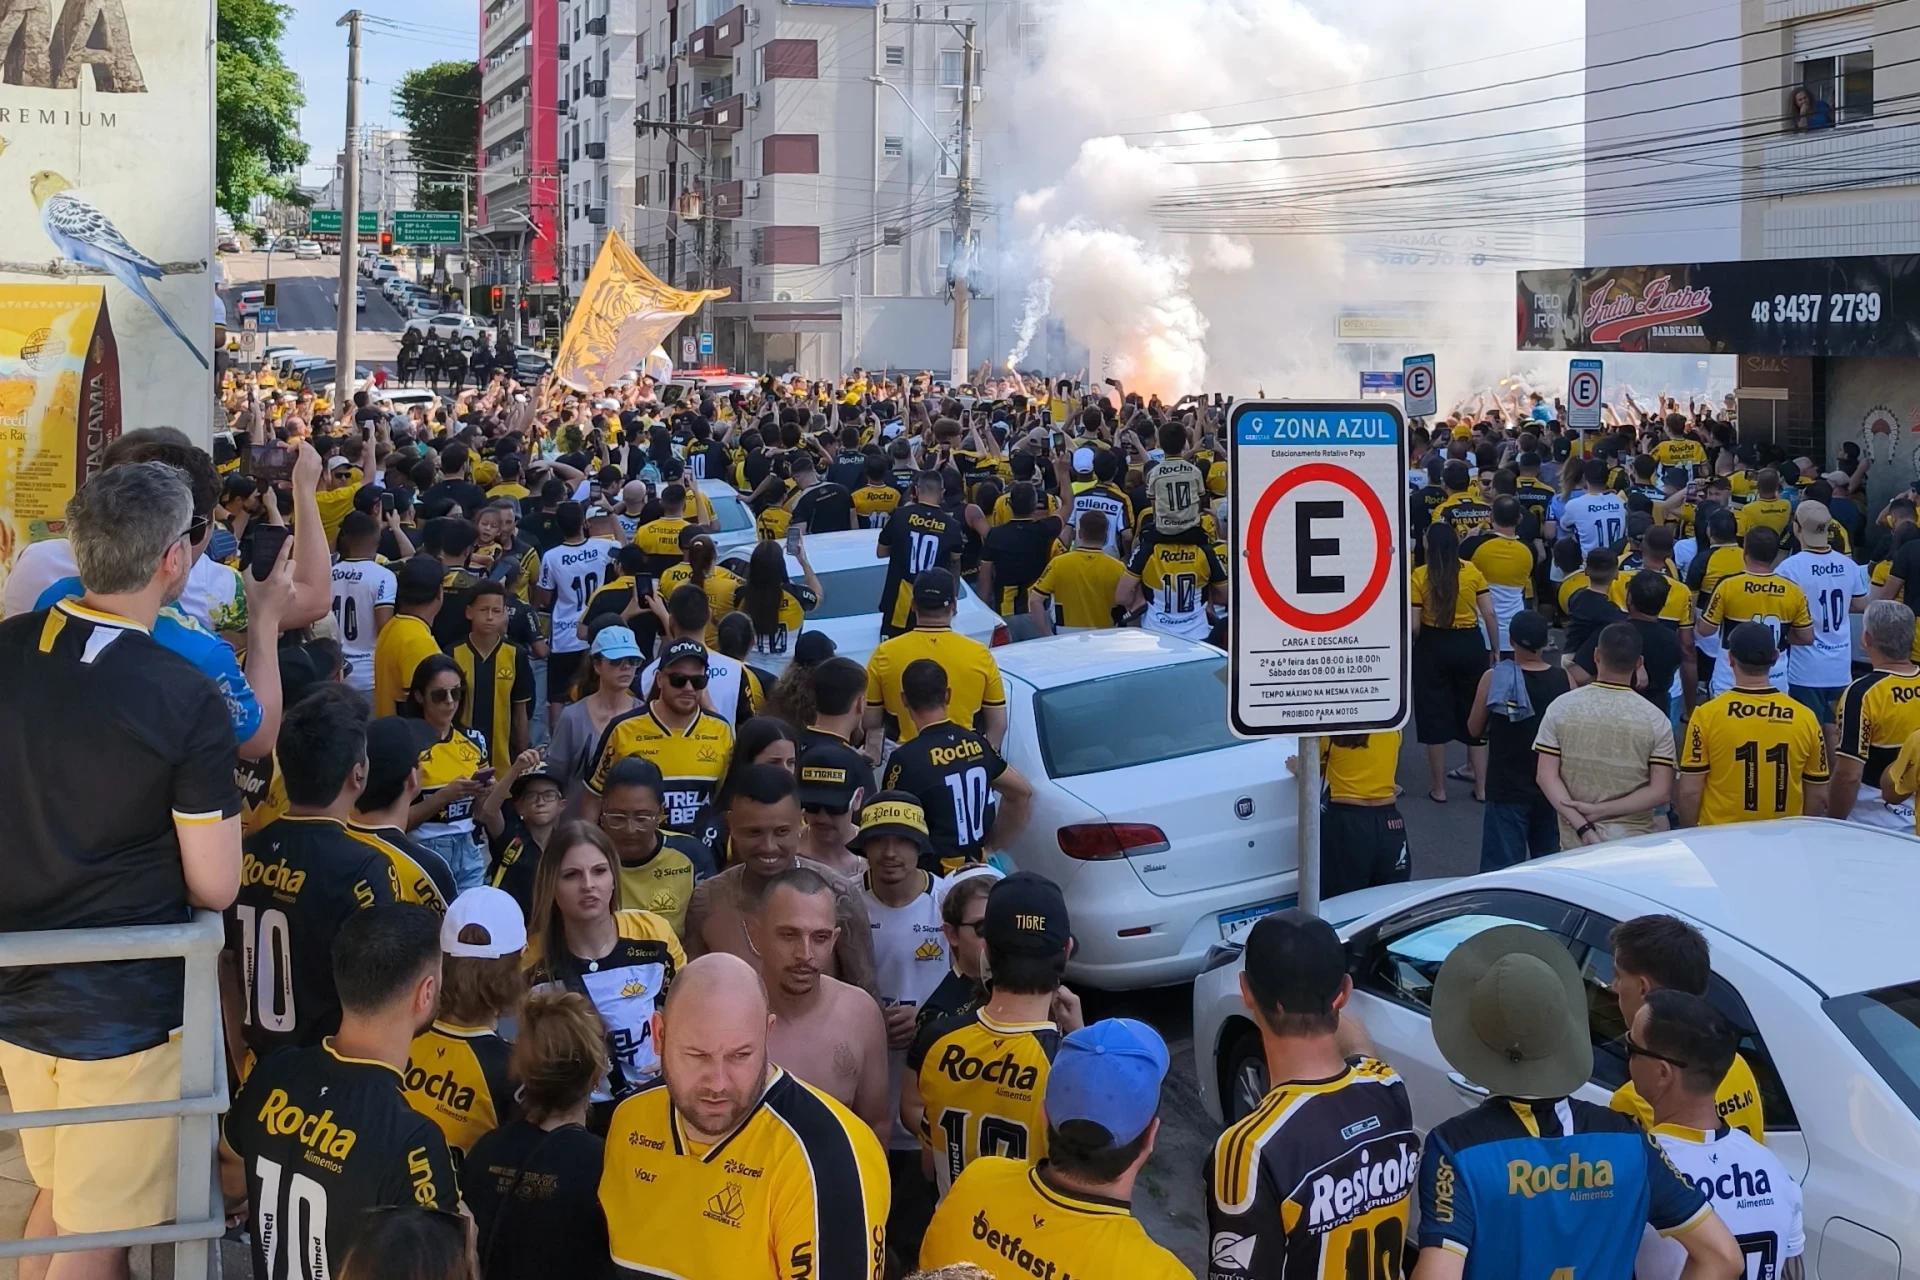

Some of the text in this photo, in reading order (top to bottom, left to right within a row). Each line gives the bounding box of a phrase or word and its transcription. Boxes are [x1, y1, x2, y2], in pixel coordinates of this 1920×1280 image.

[1534, 294, 1560, 309] RED
[1635, 275, 1712, 315] Barber
[1751, 293, 1881, 323] 48 3437 2739
[1534, 313, 1567, 329] IRON
[1652, 326, 1704, 336] BARBEARIA
[1415, 373, 1425, 391] E
[1580, 380, 1590, 399] E
[1274, 418, 1390, 438] ZONA AZUL
[1271, 449, 1365, 459] Estacionamento Rotativo Pago
[1159, 463, 1193, 475] Rocha
[867, 492, 894, 501] Rocha
[1166, 481, 1190, 512] 10
[1588, 502, 1620, 512] Rocha
[909, 513, 946, 531] Rocha
[1594, 518, 1621, 549] 10
[910, 530, 939, 574] 10
[1295, 500, 1345, 594] E
[562, 549, 598, 565] Rocha
[1160, 550, 1195, 563] Rocha
[332, 568, 363, 581] Rocha
[1812, 562, 1845, 576] Rocha
[571, 572, 598, 612] 10
[1162, 572, 1196, 614] 10
[1744, 581, 1786, 594] Rocha
[1819, 589, 1844, 633] 10
[1282, 636, 1359, 646] CARGA E DESCARGA
[1288, 657, 1305, 666] feira
[1306, 656, 1319, 665] das
[1320, 655, 1344, 665] 08:00
[1355, 654, 1380, 664] 18:00h
[1268, 668, 1296, 677] Sábado
[1298, 667, 1310, 676] das
[1312, 667, 1335, 675] 08:00
[1347, 665, 1372, 674] 12:00h
[1262, 690, 1284, 698] TEMPO
[1286, 688, 1312, 697] MÁXIMO
[1325, 688, 1349, 696] MESMA
[1282, 707, 1358, 718] PROIBIDO PARA MOTOS
[1728, 701, 1794, 719] Rocha
[930, 739, 983, 766] Rocha
[1736, 741, 1789, 812] 11
[448, 800, 473, 818] BET
[944, 766, 987, 846] 10
[671, 807, 700, 825] BET
[1016, 914, 1046, 931] TIGRE
[237, 904, 296, 1032] 10
[938, 1044, 1038, 1092] Rocha
[994, 1086, 1032, 1102] Alimentos
[435, 1103, 468, 1124] Alimentos
[258, 1088, 359, 1161] Rocha
[639, 1134, 665, 1151] Sicredi
[304, 1150, 343, 1175] Alimentos
[737, 1162, 764, 1178] Sicredi
[634, 1167, 658, 1183] VOLT
[1507, 1152, 1615, 1199] Rocha
[1569, 1188, 1615, 1201] Alimentos
[1736, 1197, 1775, 1210] Alimentos
[255, 1155, 331, 1280] 10
